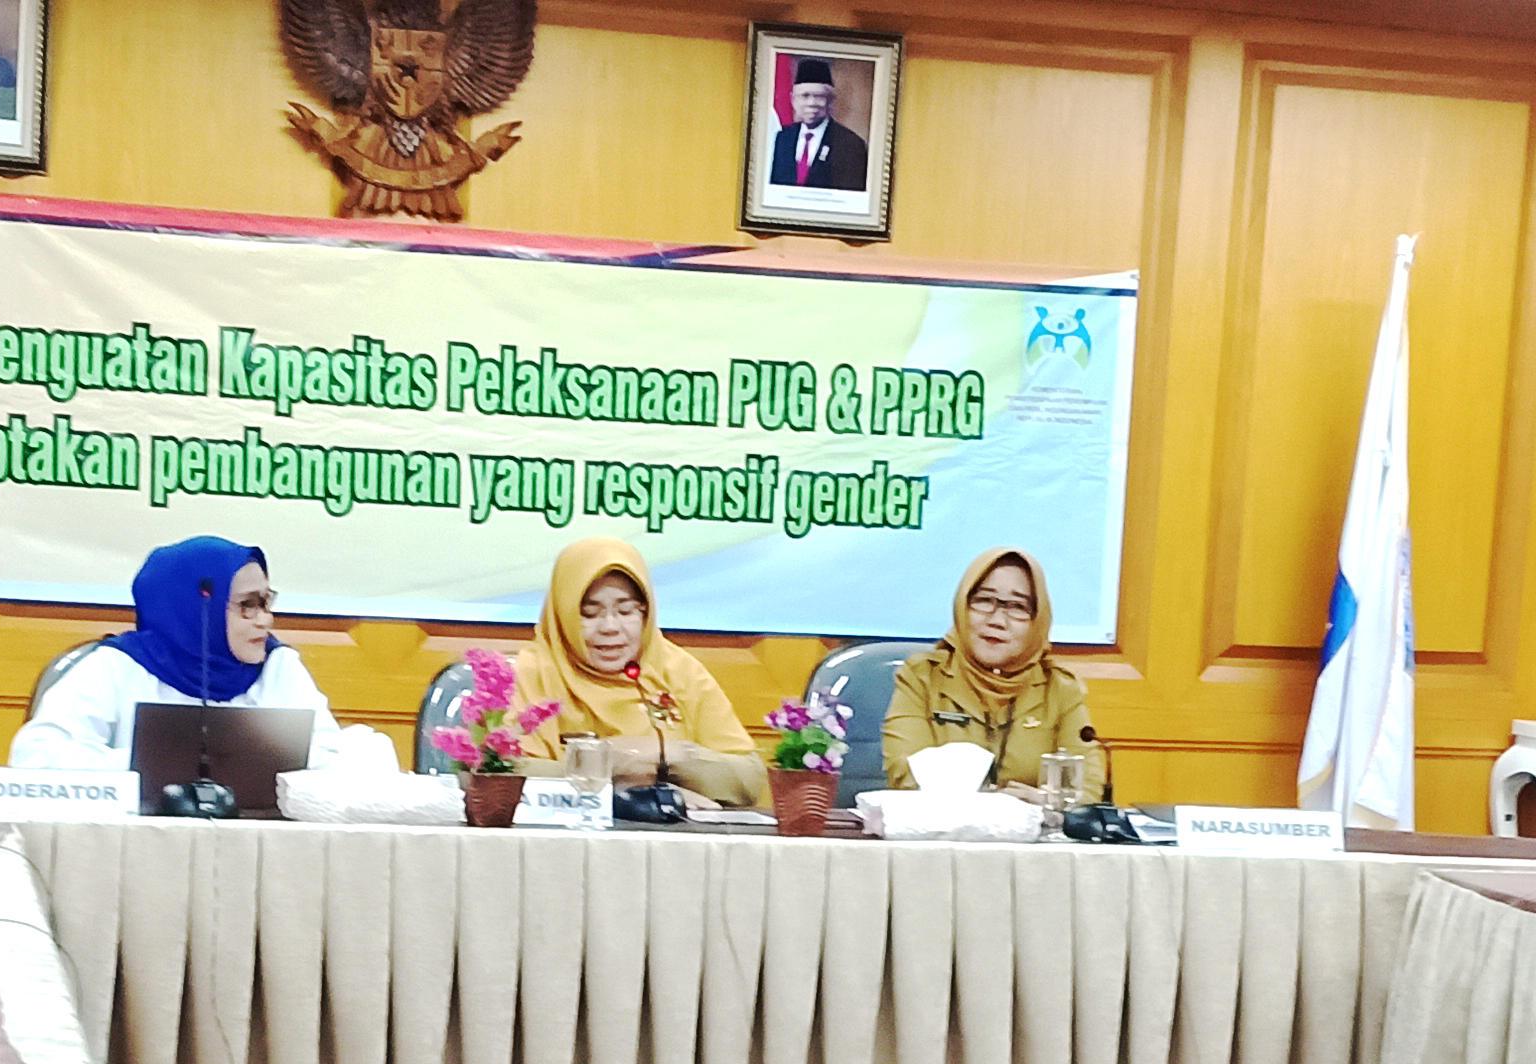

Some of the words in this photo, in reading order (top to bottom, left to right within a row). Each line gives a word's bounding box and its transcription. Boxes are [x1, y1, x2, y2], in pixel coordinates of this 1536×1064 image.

[220, 326, 437, 416] Kapasitas
[447, 341, 719, 427] Pelaksanaan
[729, 358, 817, 432] PUG
[827, 363, 865, 434] &
[871, 366, 985, 440] PPRG
[151, 426, 461, 517] pembangunan
[468, 453, 574, 528] yang
[583, 454, 779, 533] responsif
[784, 460, 930, 539] gender
[1191, 820, 1331, 837] NARASUMBER
